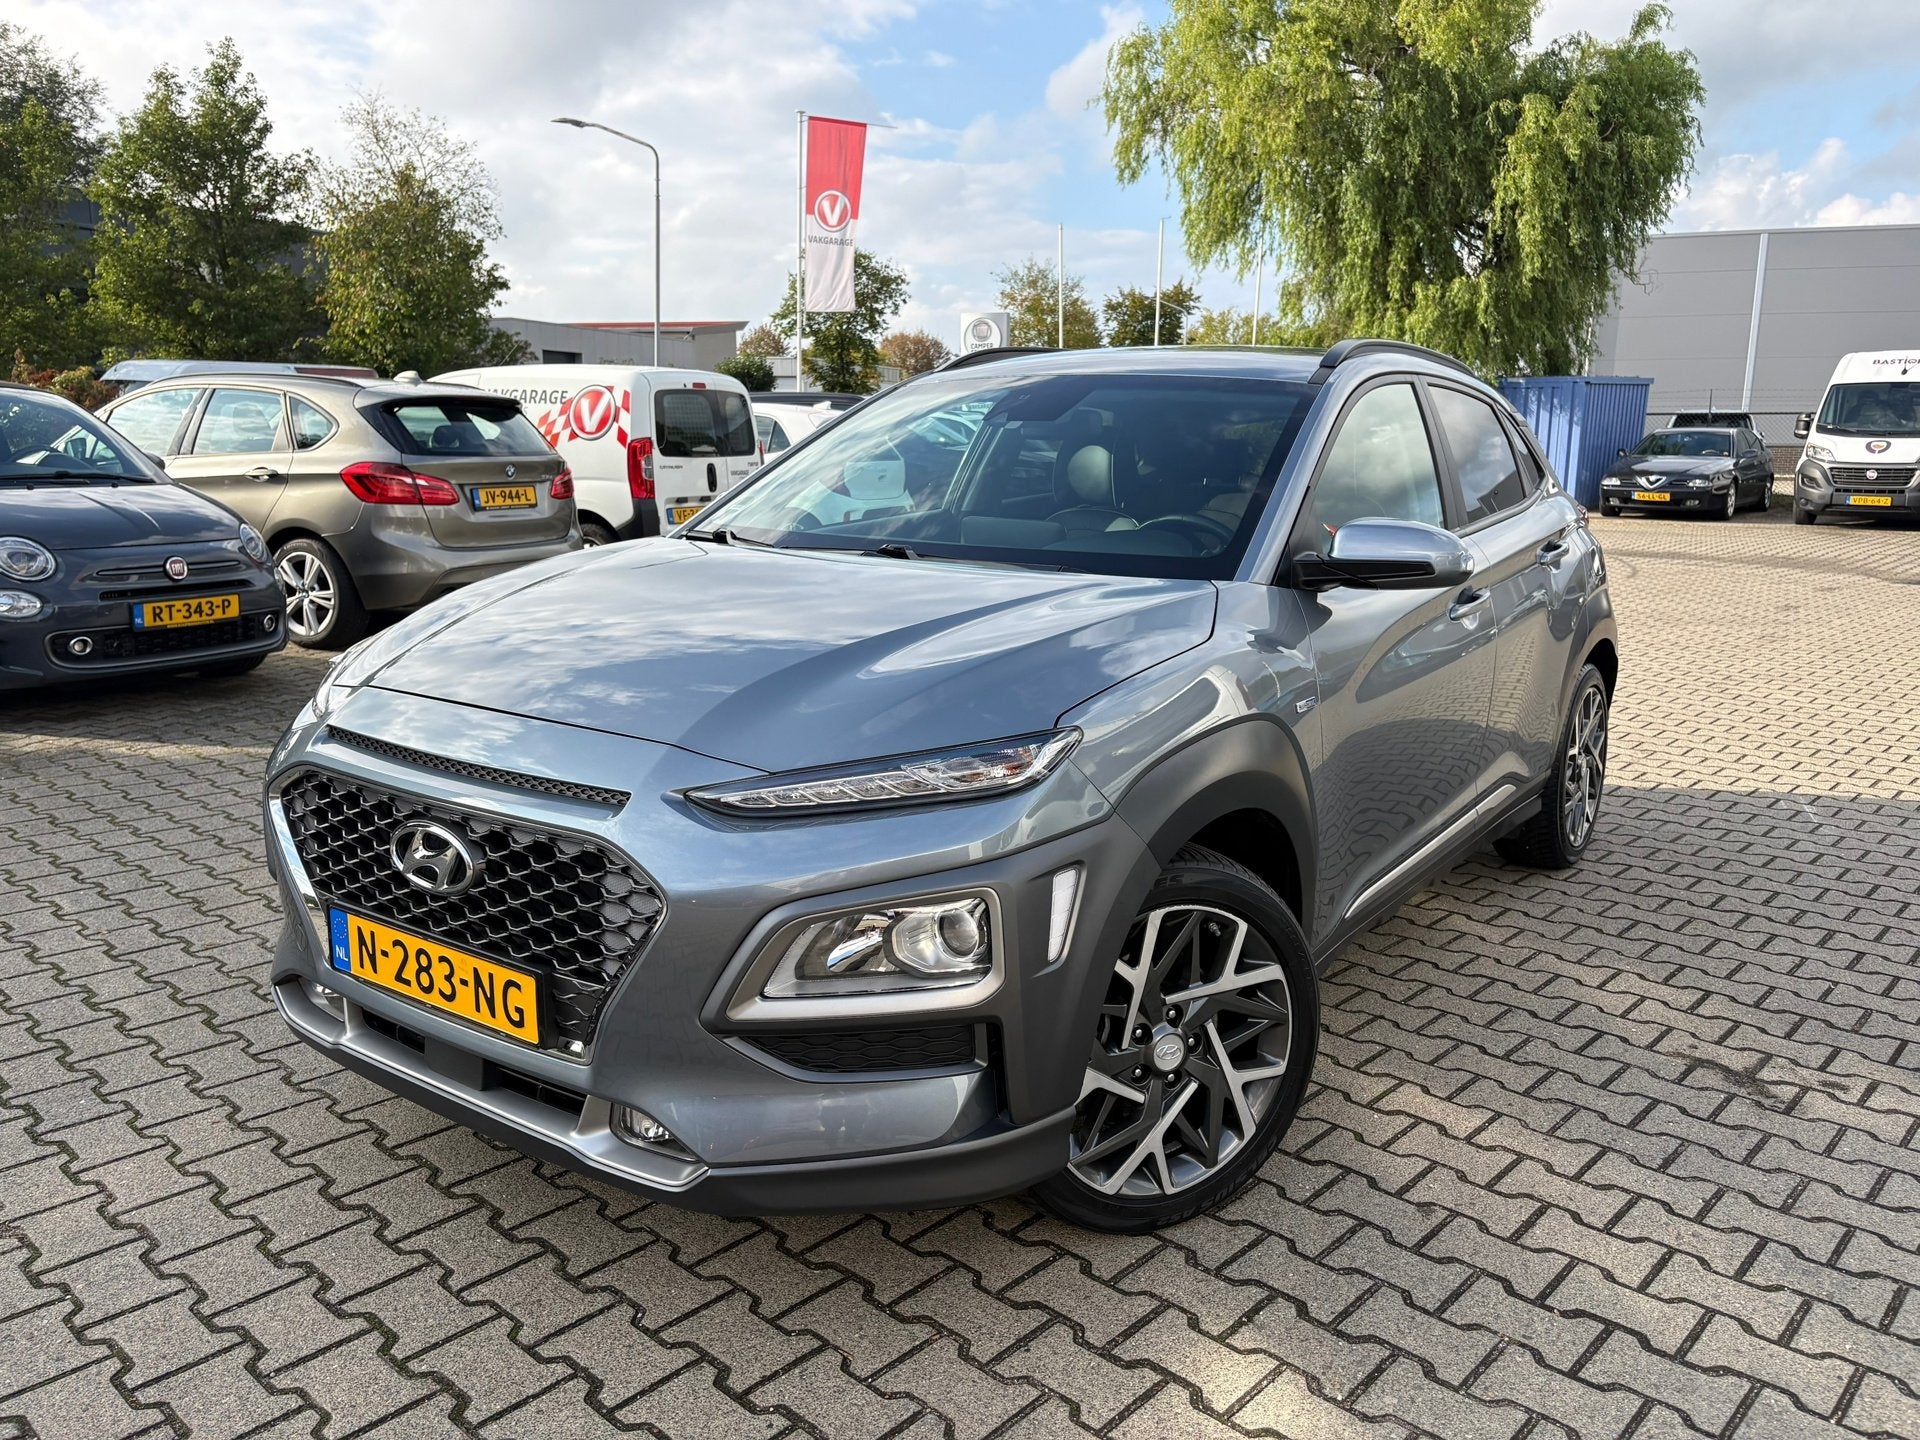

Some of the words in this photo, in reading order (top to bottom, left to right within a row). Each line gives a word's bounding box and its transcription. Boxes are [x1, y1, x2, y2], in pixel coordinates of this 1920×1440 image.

[808, 234, 854, 247] VAKGARAGE
[484, 489, 531, 504] JV-944-L
[171, 563, 184, 574] FIAT
[152, 598, 231, 623] RT-343-P
[335, 944, 349, 962] NL
[357, 925, 525, 1029] N-283-NG
